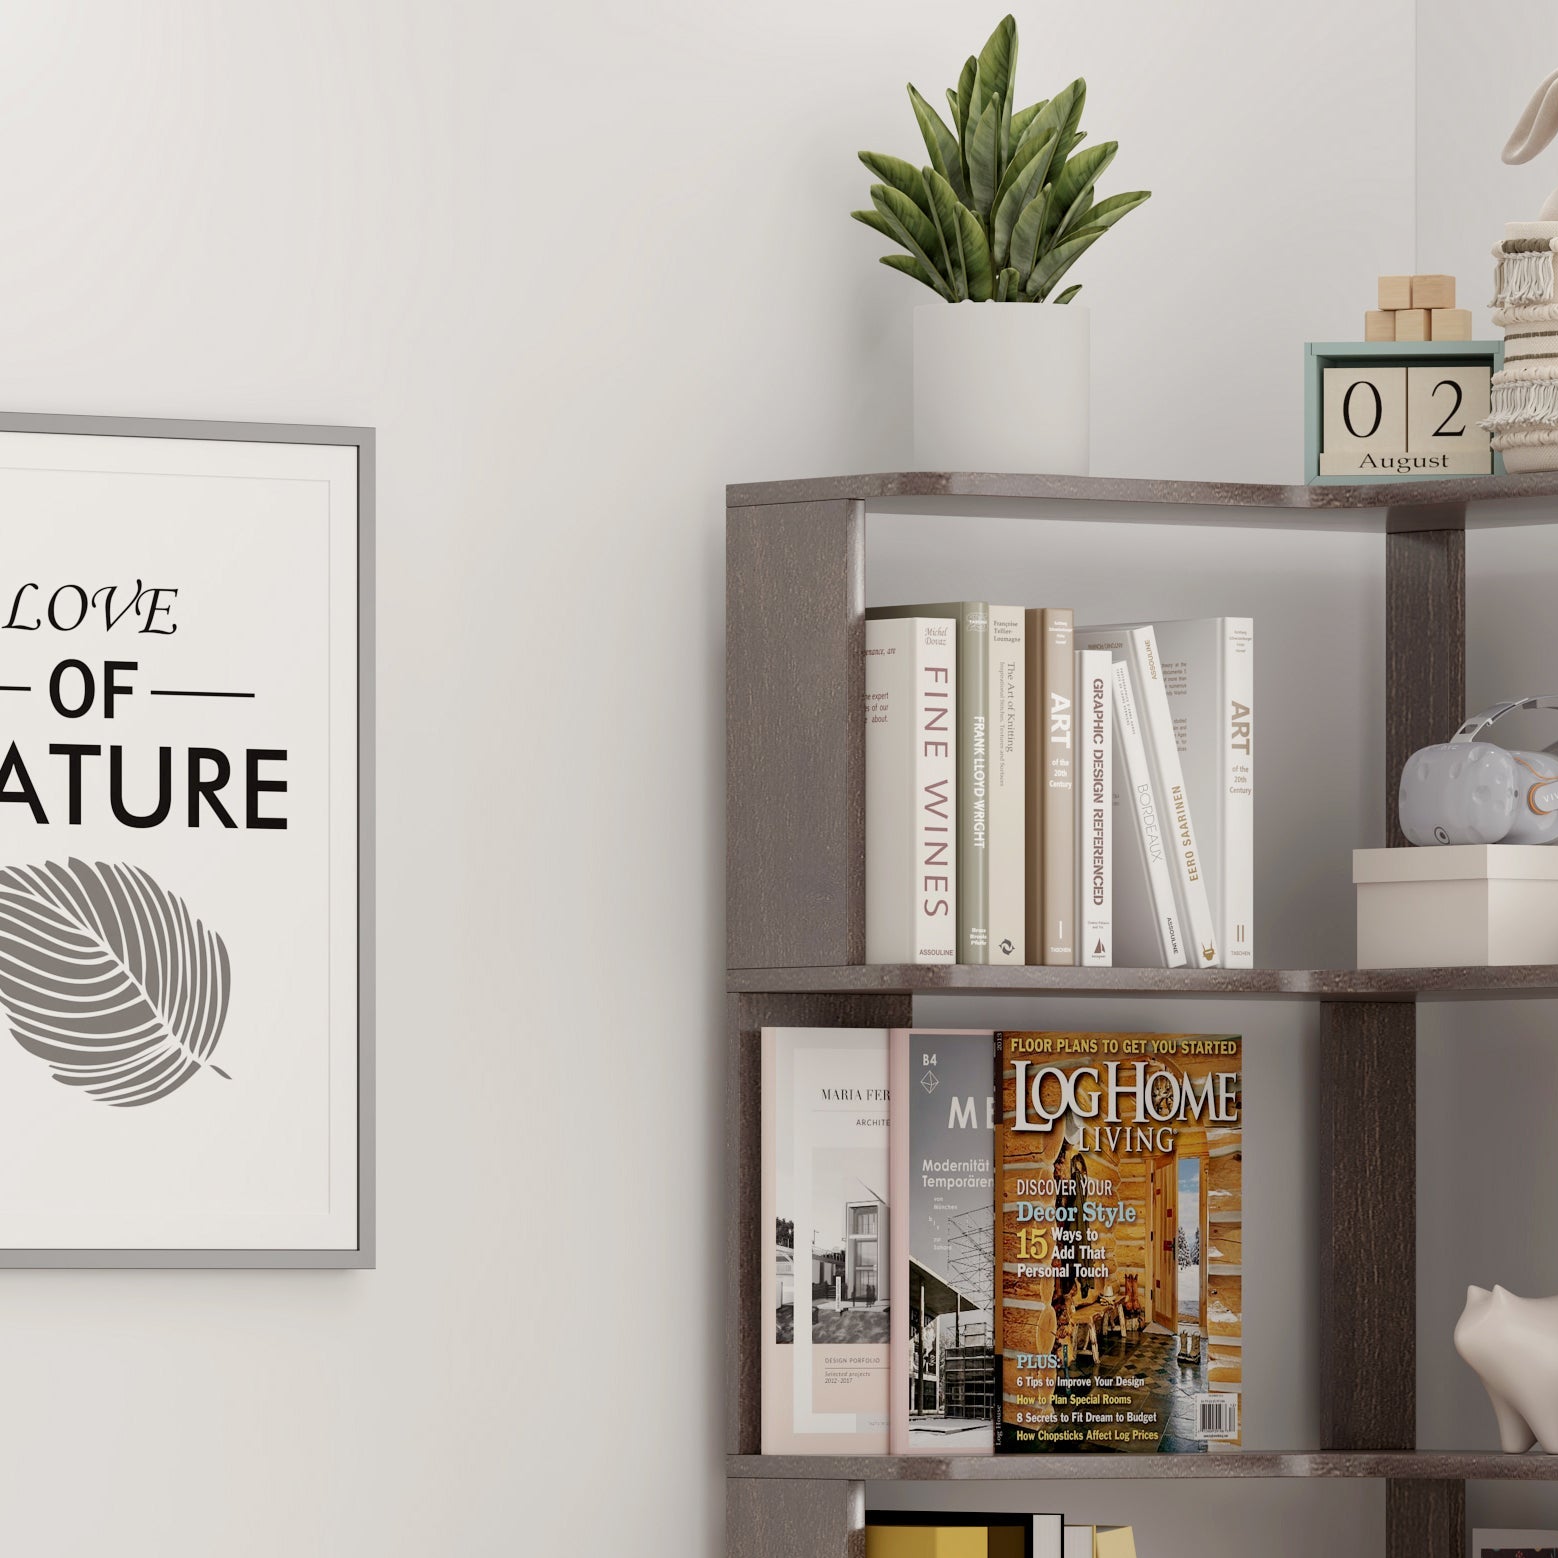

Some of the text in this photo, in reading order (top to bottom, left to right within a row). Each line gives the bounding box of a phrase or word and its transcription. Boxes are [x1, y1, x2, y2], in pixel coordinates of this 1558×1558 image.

[1359, 453, 1449, 473] August
[2, 579, 178, 635] LOVE
[49, 658, 138, 719] OF
[1050, 692, 1071, 748] ART
[1231, 701, 1250, 755] ART
[974, 716, 985, 848] FRANK LLOYD WRIGHT
[924, 667, 949, 916] FINE WINES
[1093, 678, 1104, 906] GRAPHIC DESIGN REFERENCED
[1137, 784, 1163, 863] BORDEAUX
[1171, 785, 1199, 882] EERO SAARINEN
[919, 949, 953, 957] ASSOULINE
[1011, 1038, 1237, 1055] FLOOR PLANS TO GET YOU STARTED
[922, 1054, 937, 1066] B4
[821, 1088, 862, 1101] MARIA
[922, 1159, 990, 1172] Modernität
[1017, 1179, 1112, 1196] DISCOVER YOUR
[1016, 1201, 1136, 1228] Decor Style
[1016, 1228, 1048, 1259] 15
[1051, 1227, 1098, 1243] Ways to
[1051, 1245, 1105, 1260] Add That
[1017, 1263, 1108, 1278] Personal Touch
[1016, 1354, 1061, 1369] PLUS:
[1016, 1376, 1145, 1389] 6 Tips to Improve Your Design
[1016, 1394, 1132, 1407] How to Plan Special Rooms
[1016, 1412, 1157, 1425] 8 Secrets to Fit Dream to Budget
[1016, 1430, 1159, 1443] How Chopsticks Affect Log Prices
